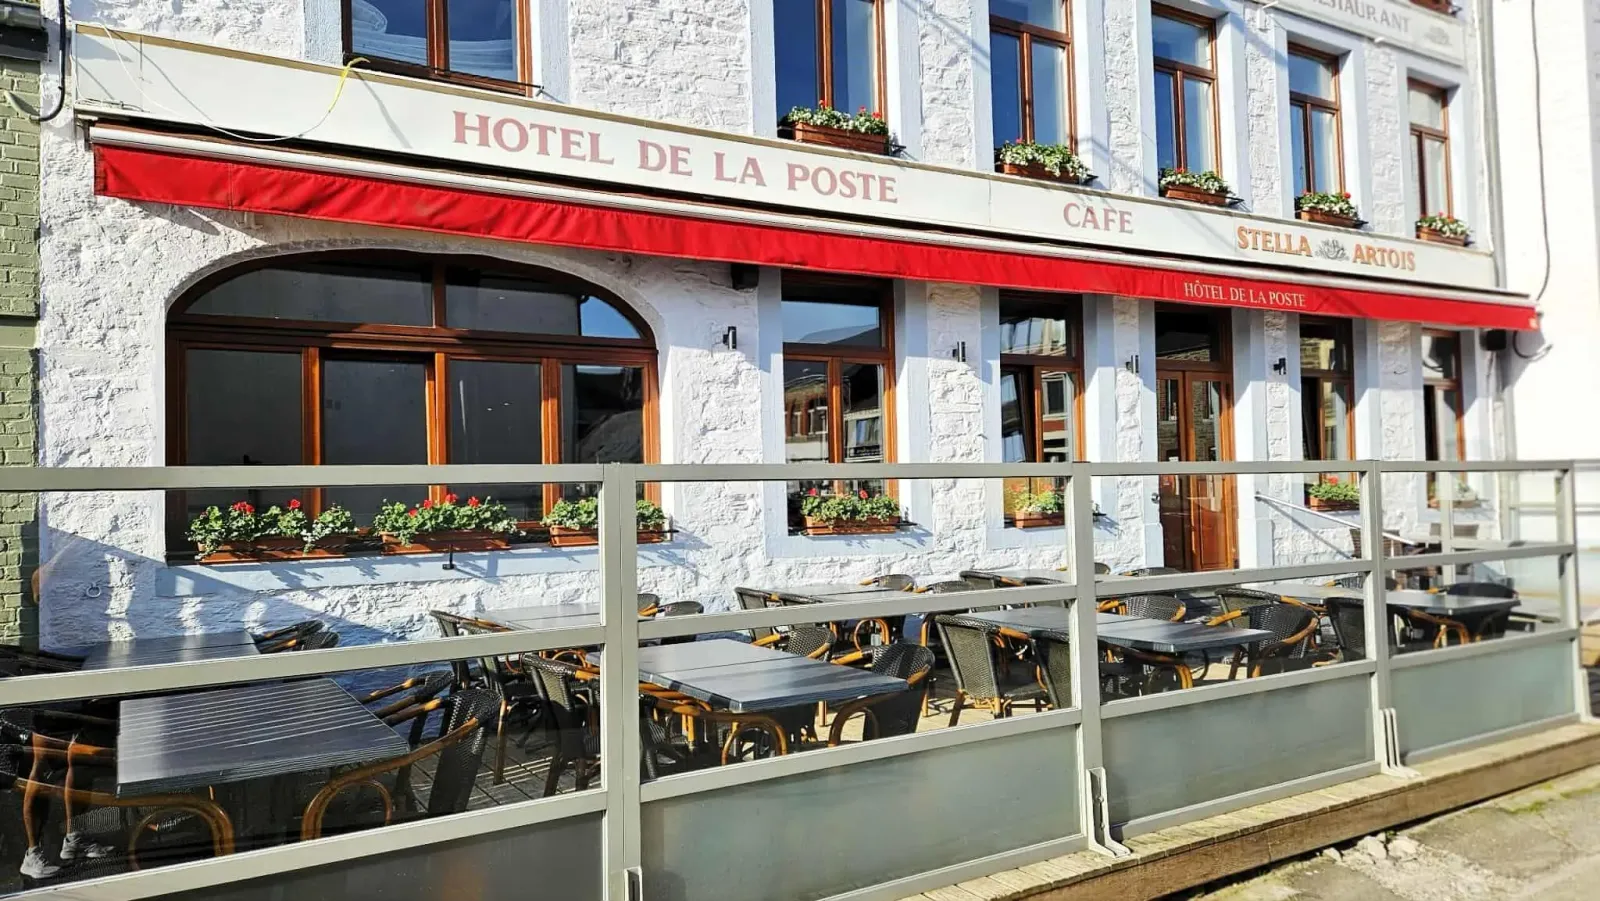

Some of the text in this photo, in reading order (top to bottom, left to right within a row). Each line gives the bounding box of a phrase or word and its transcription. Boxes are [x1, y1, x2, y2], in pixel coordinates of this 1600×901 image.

[1312, 0, 1410, 32] STAURANT
[453, 110, 899, 204] HOTEL DE LA POSTE
[1063, 202, 1134, 234] CAFE
[1236, 225, 1416, 272] STELLA ARTOIS
[1184, 280, 1306, 307] HÔTEL DE LA POSTE
